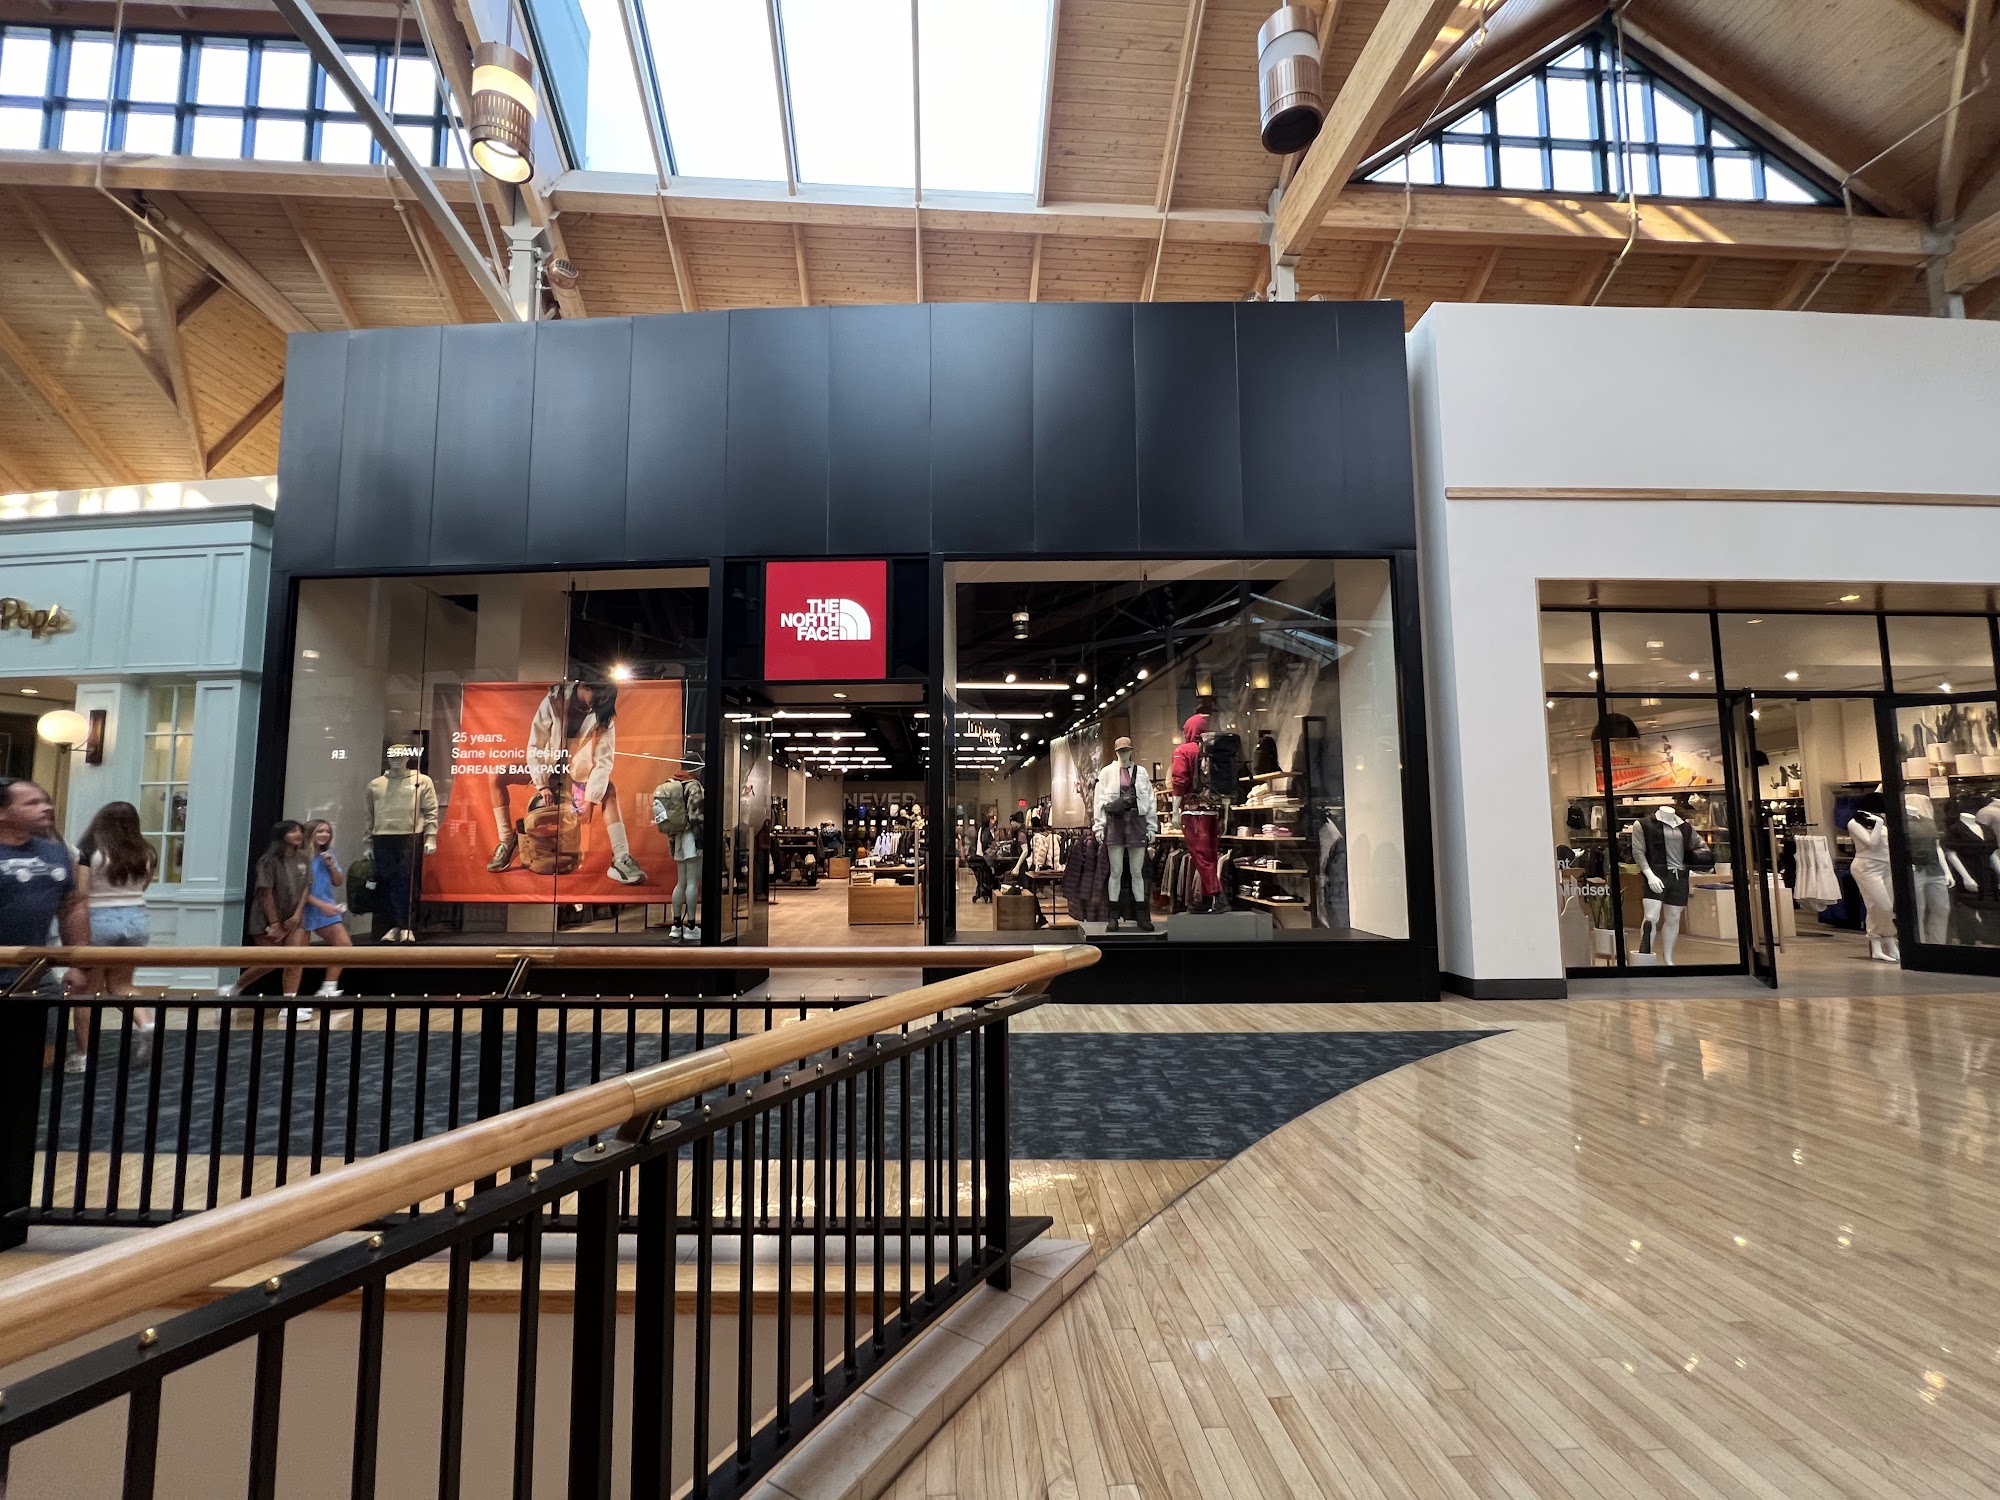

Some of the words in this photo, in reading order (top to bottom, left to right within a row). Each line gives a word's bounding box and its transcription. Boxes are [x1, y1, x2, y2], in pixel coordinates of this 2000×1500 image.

[806, 598, 840, 613] THE
[780, 612, 840, 628] NORTH
[797, 626, 840, 641] FACE
[452, 732, 467, 743] 25
[470, 733, 506, 746] years.
[451, 747, 486, 759] Same
[489, 747, 525, 759] iconic
[528, 747, 572, 761] design.
[450, 764, 507, 775] BOREALIS
[509, 763, 571, 775] BACKPACK
[843, 792, 917, 811] NEVER
